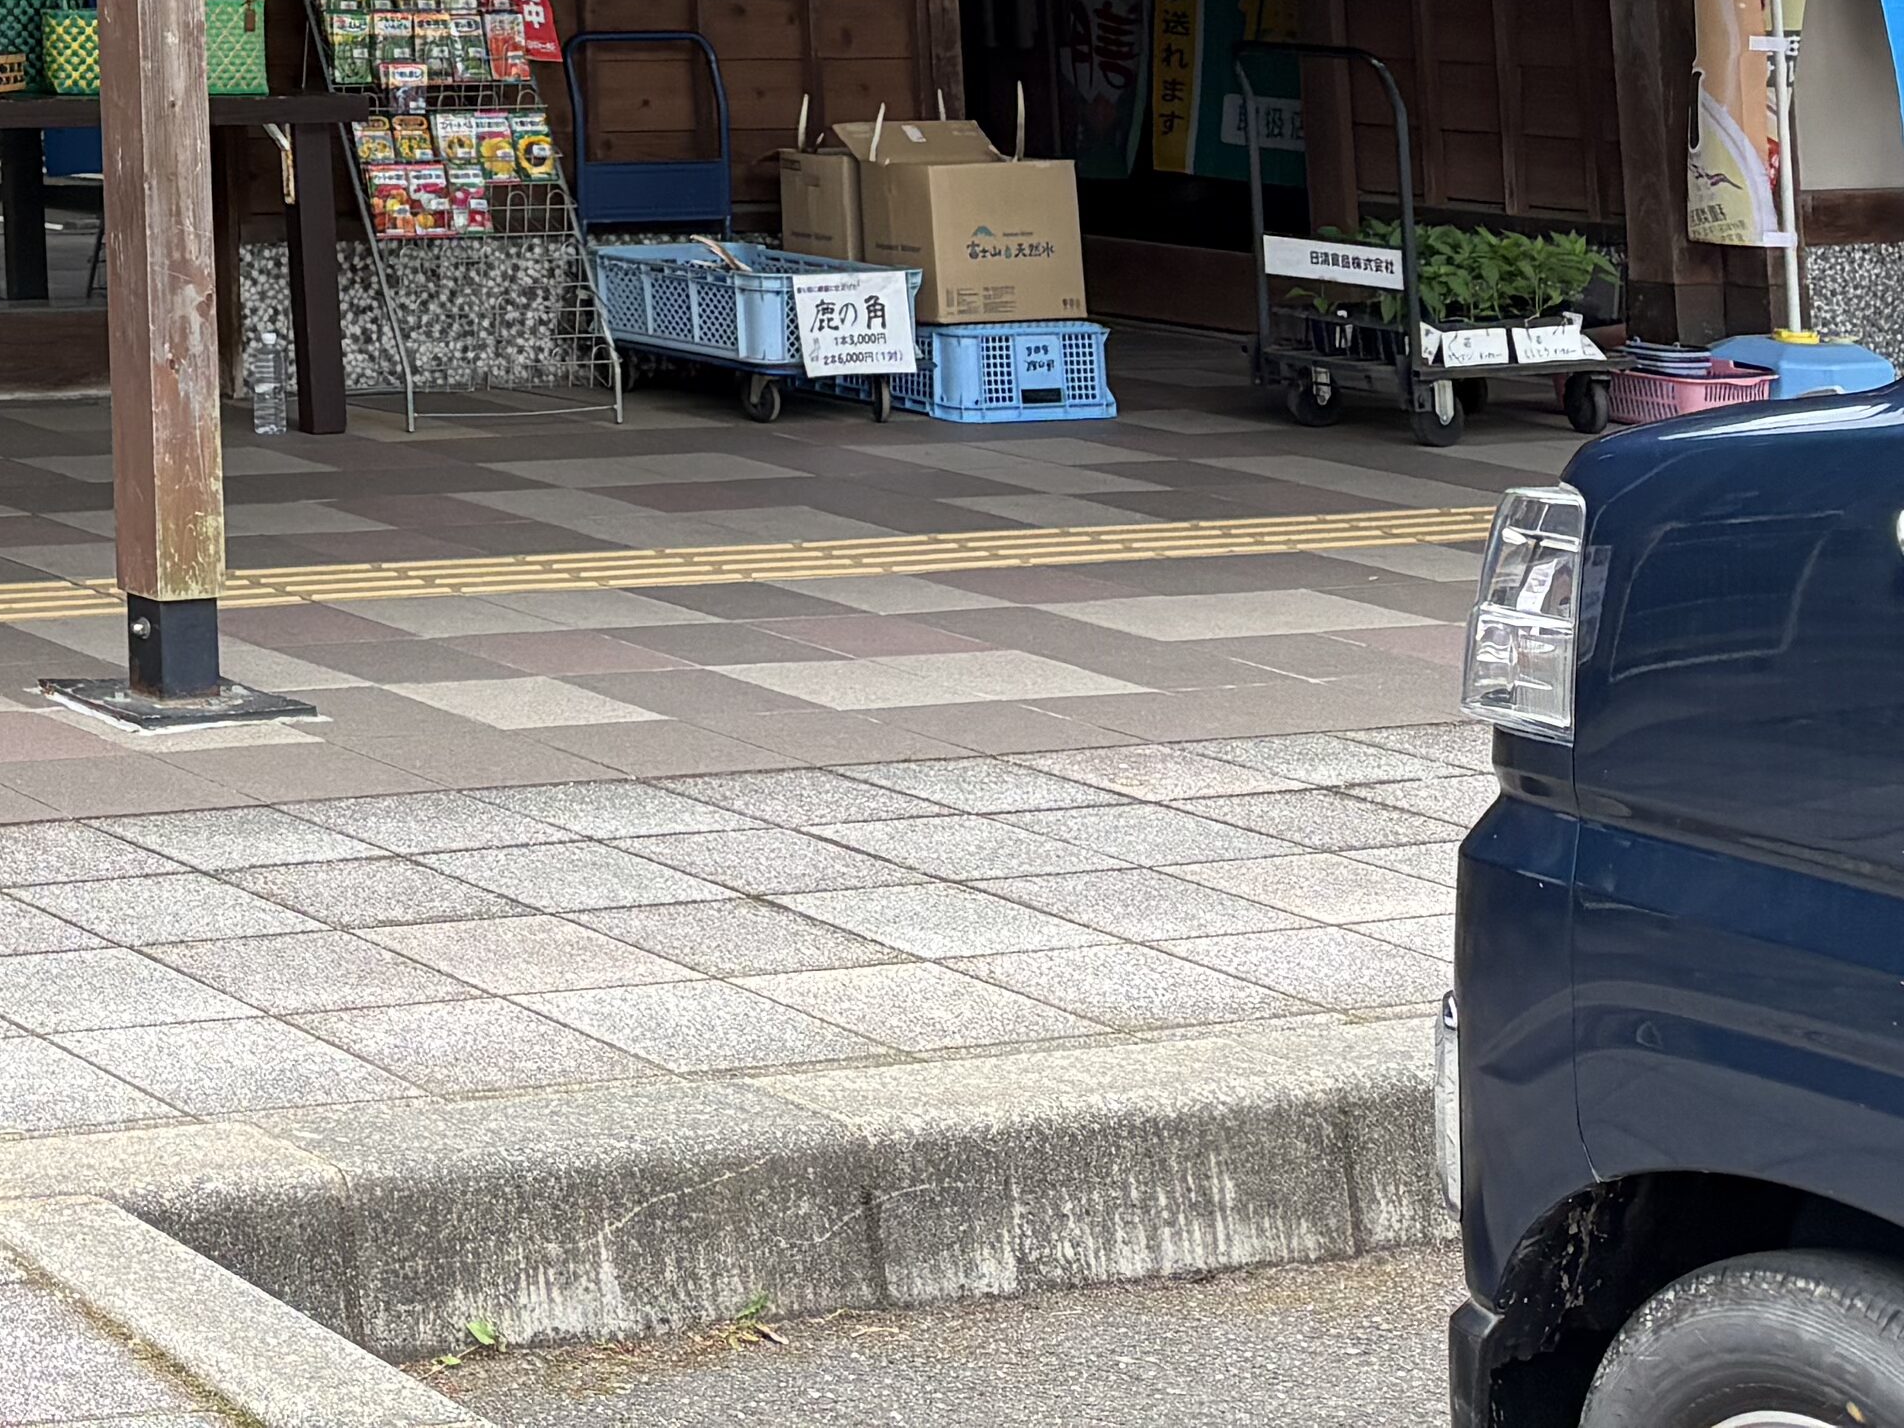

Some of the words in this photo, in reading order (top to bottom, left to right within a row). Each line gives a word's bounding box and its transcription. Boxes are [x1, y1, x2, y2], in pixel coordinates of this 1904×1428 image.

[1310, 250, 1395, 275] 日清食品株式会社
[810, 295, 887, 333] 鹿の角
[834, 333, 887, 346] 1本3,000円
